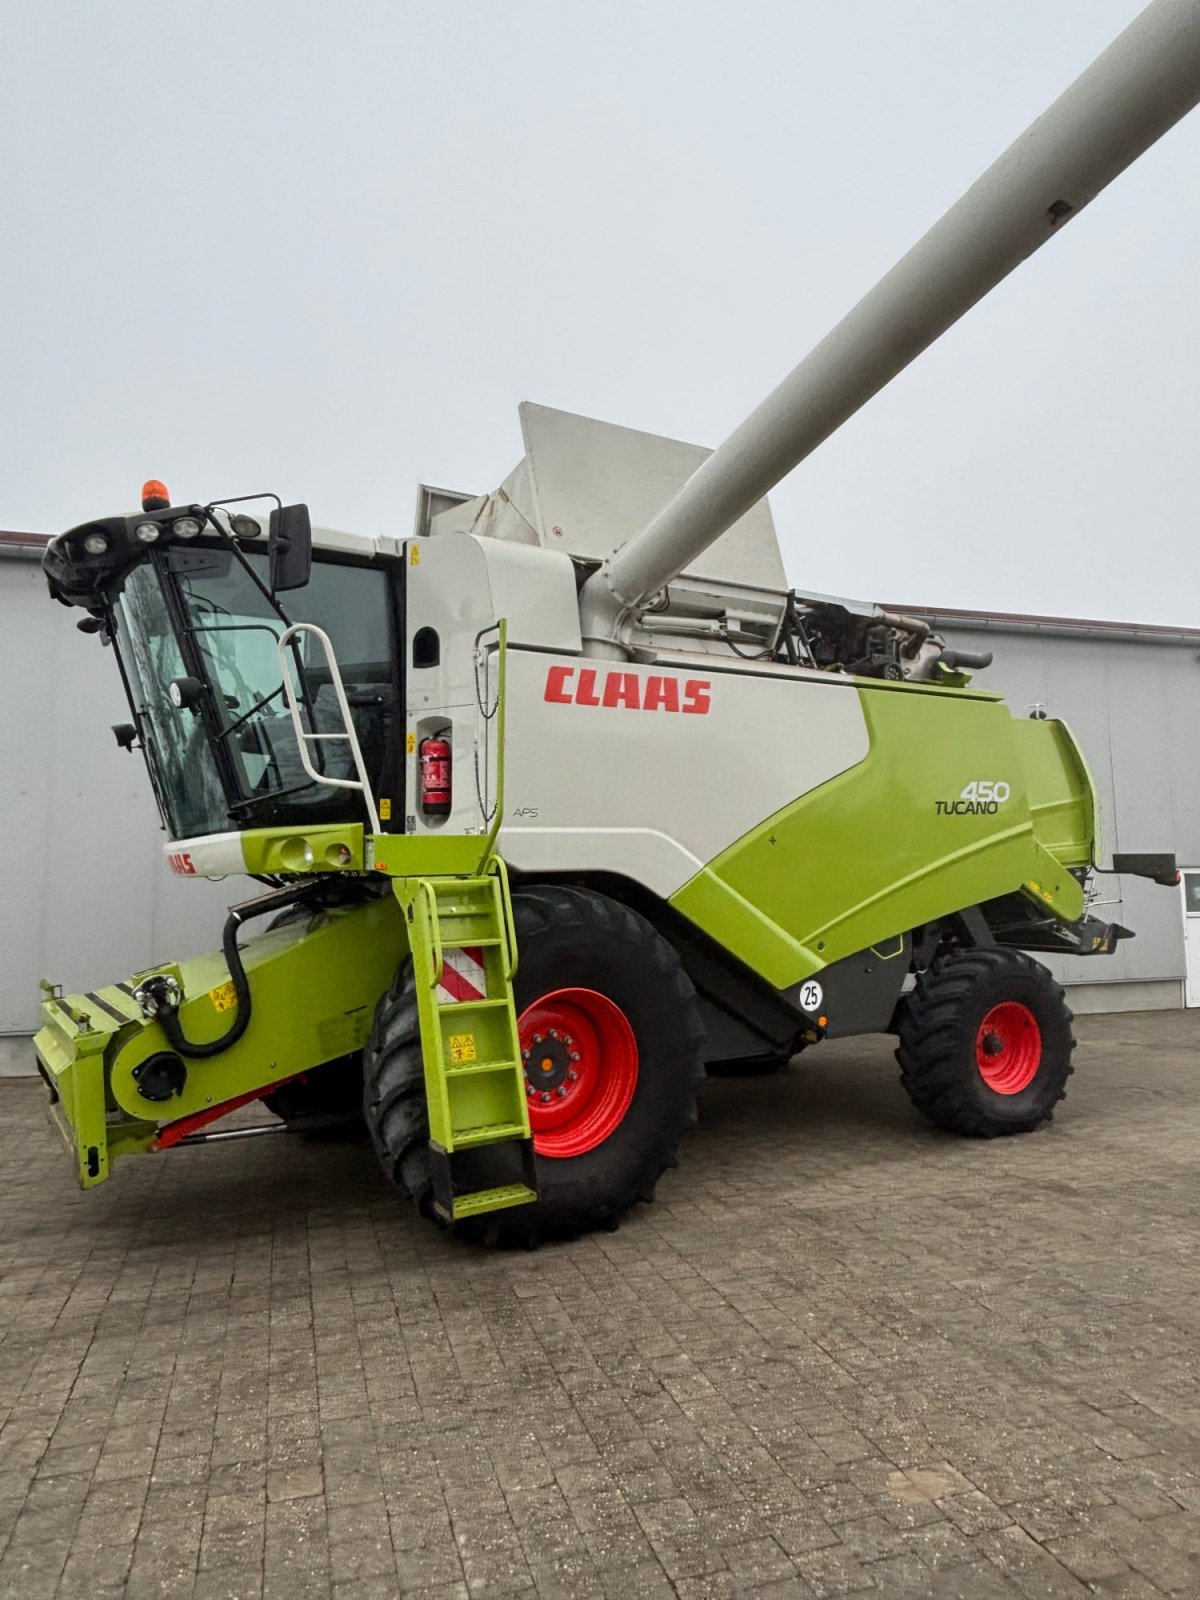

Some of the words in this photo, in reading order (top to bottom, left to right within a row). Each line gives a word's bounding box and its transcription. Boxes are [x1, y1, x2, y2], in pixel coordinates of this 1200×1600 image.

[544, 666, 711, 714] CLAAS
[961, 781, 1009, 803] 450
[513, 808, 539, 818] APS
[935, 801, 998, 815] TUCANO
[805, 986, 818, 1005] 25
